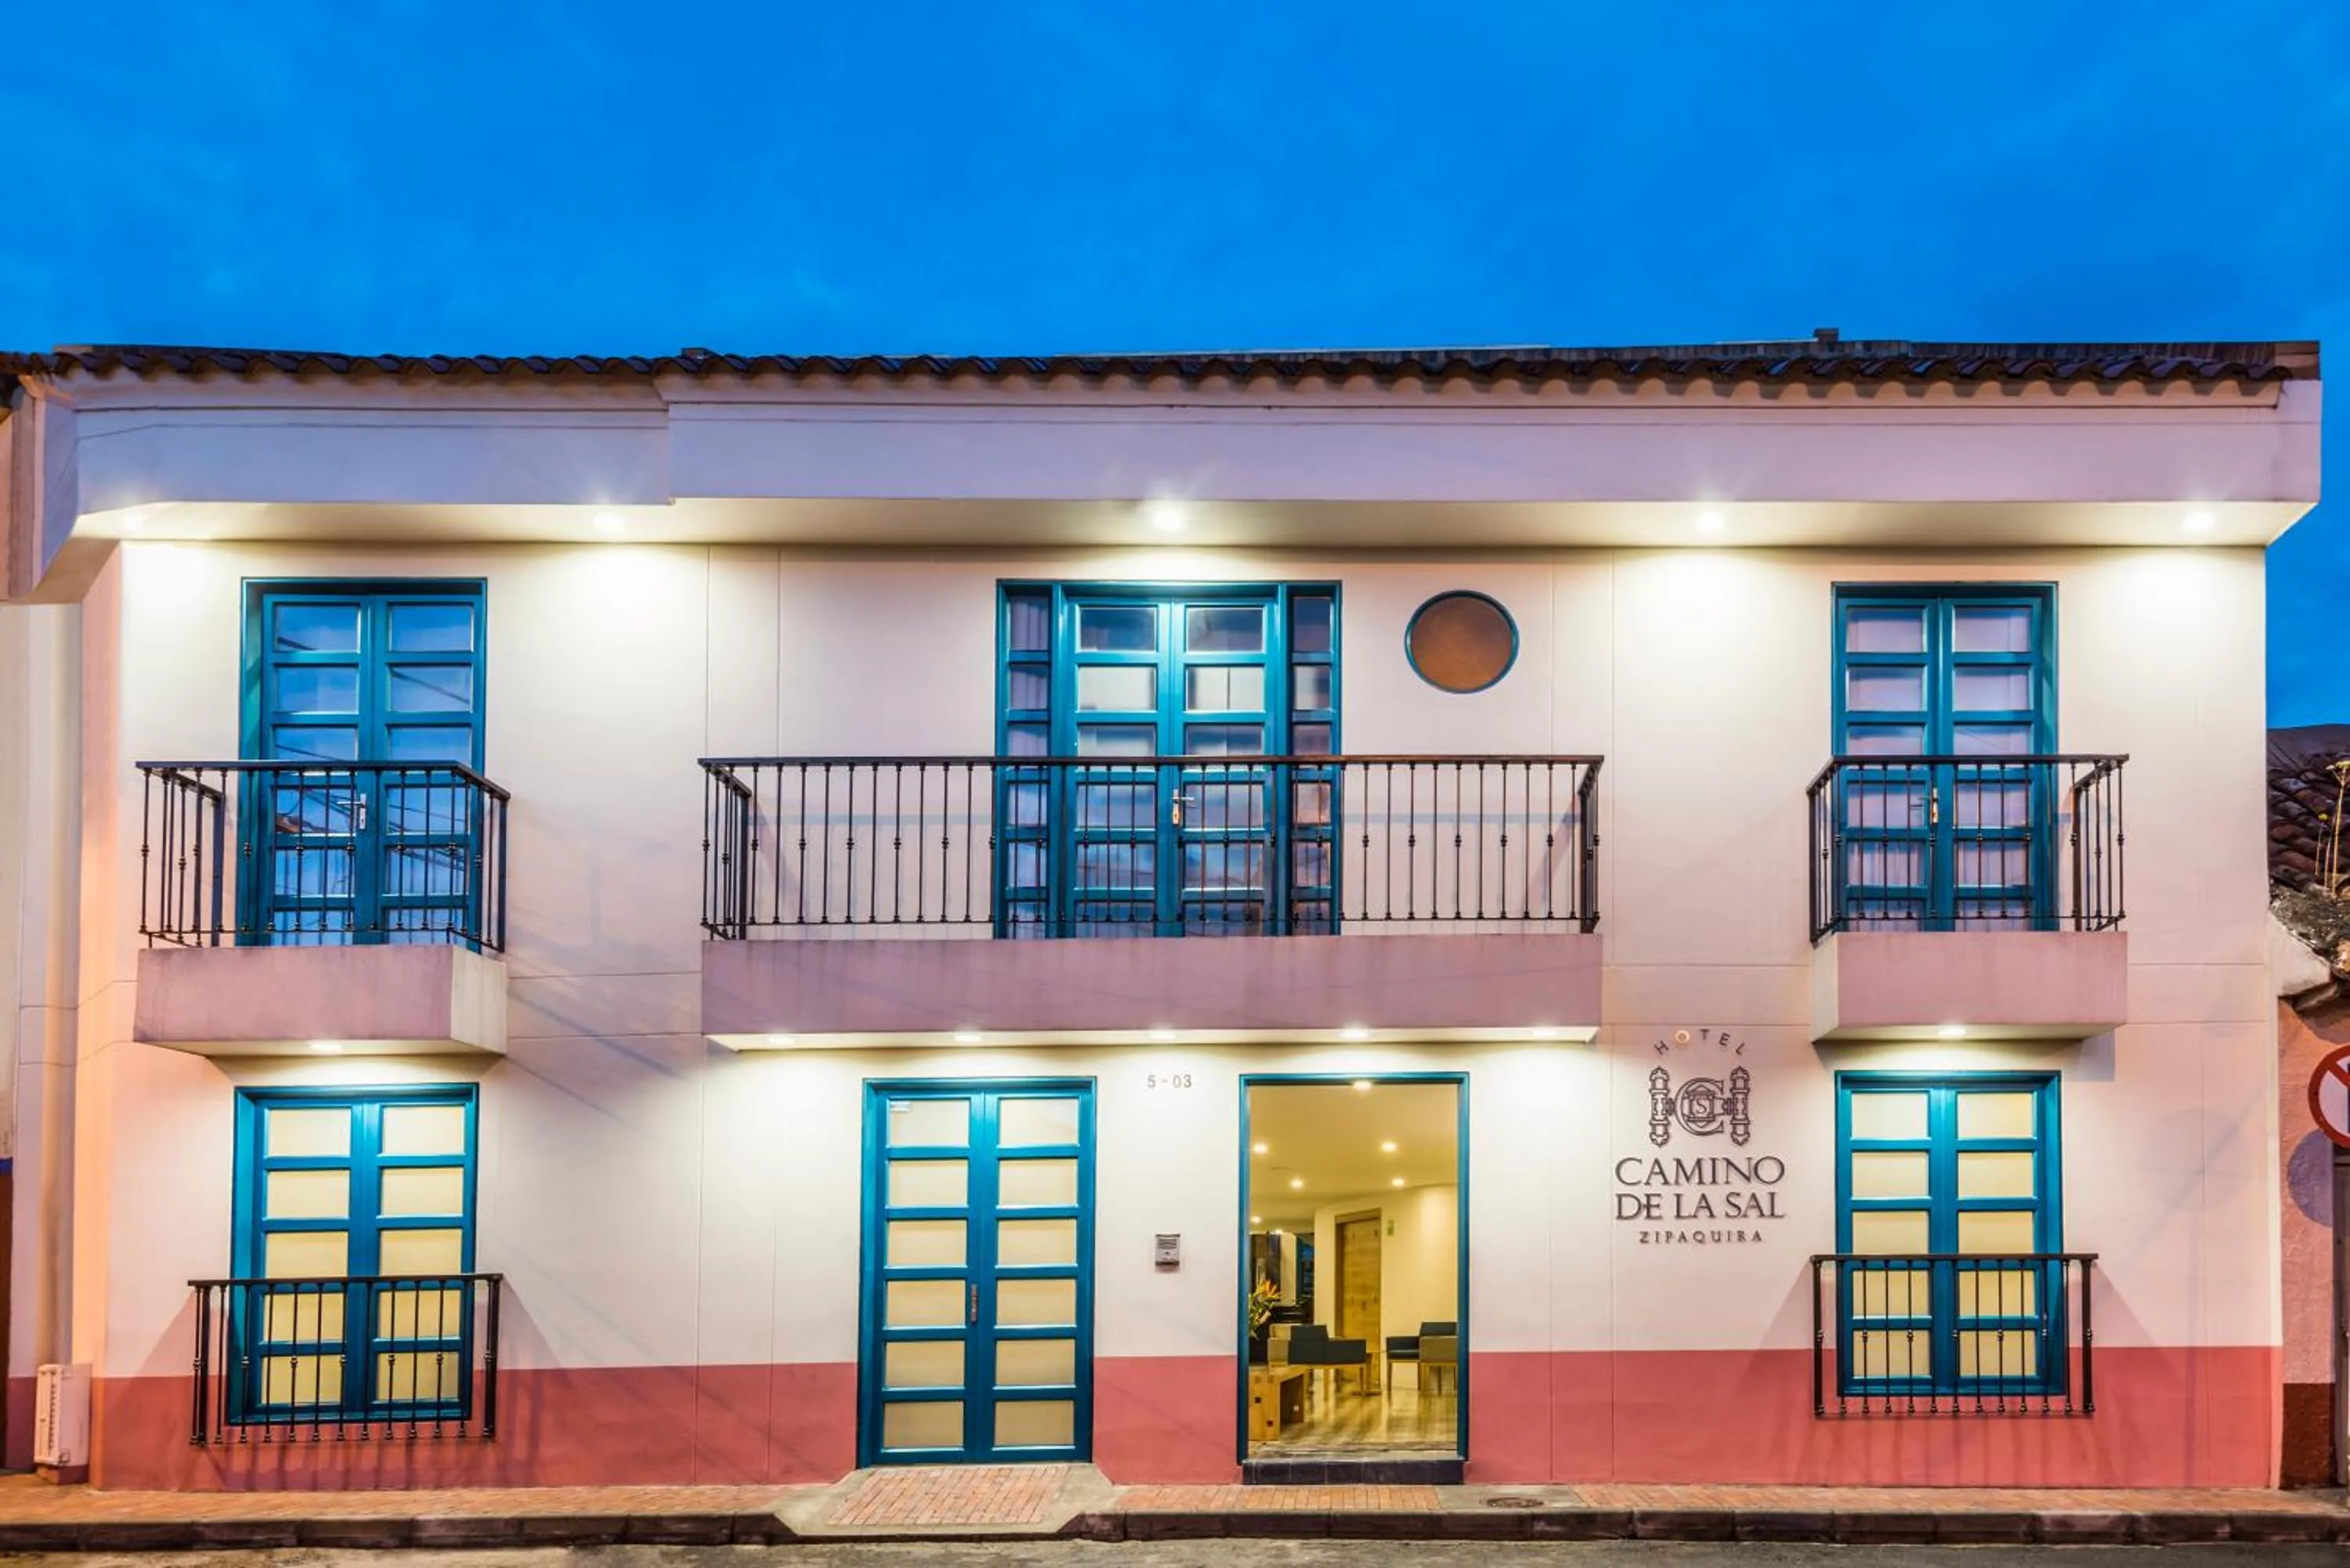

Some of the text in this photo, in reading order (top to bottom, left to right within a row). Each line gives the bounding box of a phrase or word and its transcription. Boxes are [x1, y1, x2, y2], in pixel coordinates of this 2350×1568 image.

[1654, 1028, 1747, 1056] HOTEL
[1615, 1156, 1785, 1186] CAMINO
[1615, 1192, 1786, 1220] DE LA SAL
[1639, 1230, 1762, 1244] ZIPAQUIRA
